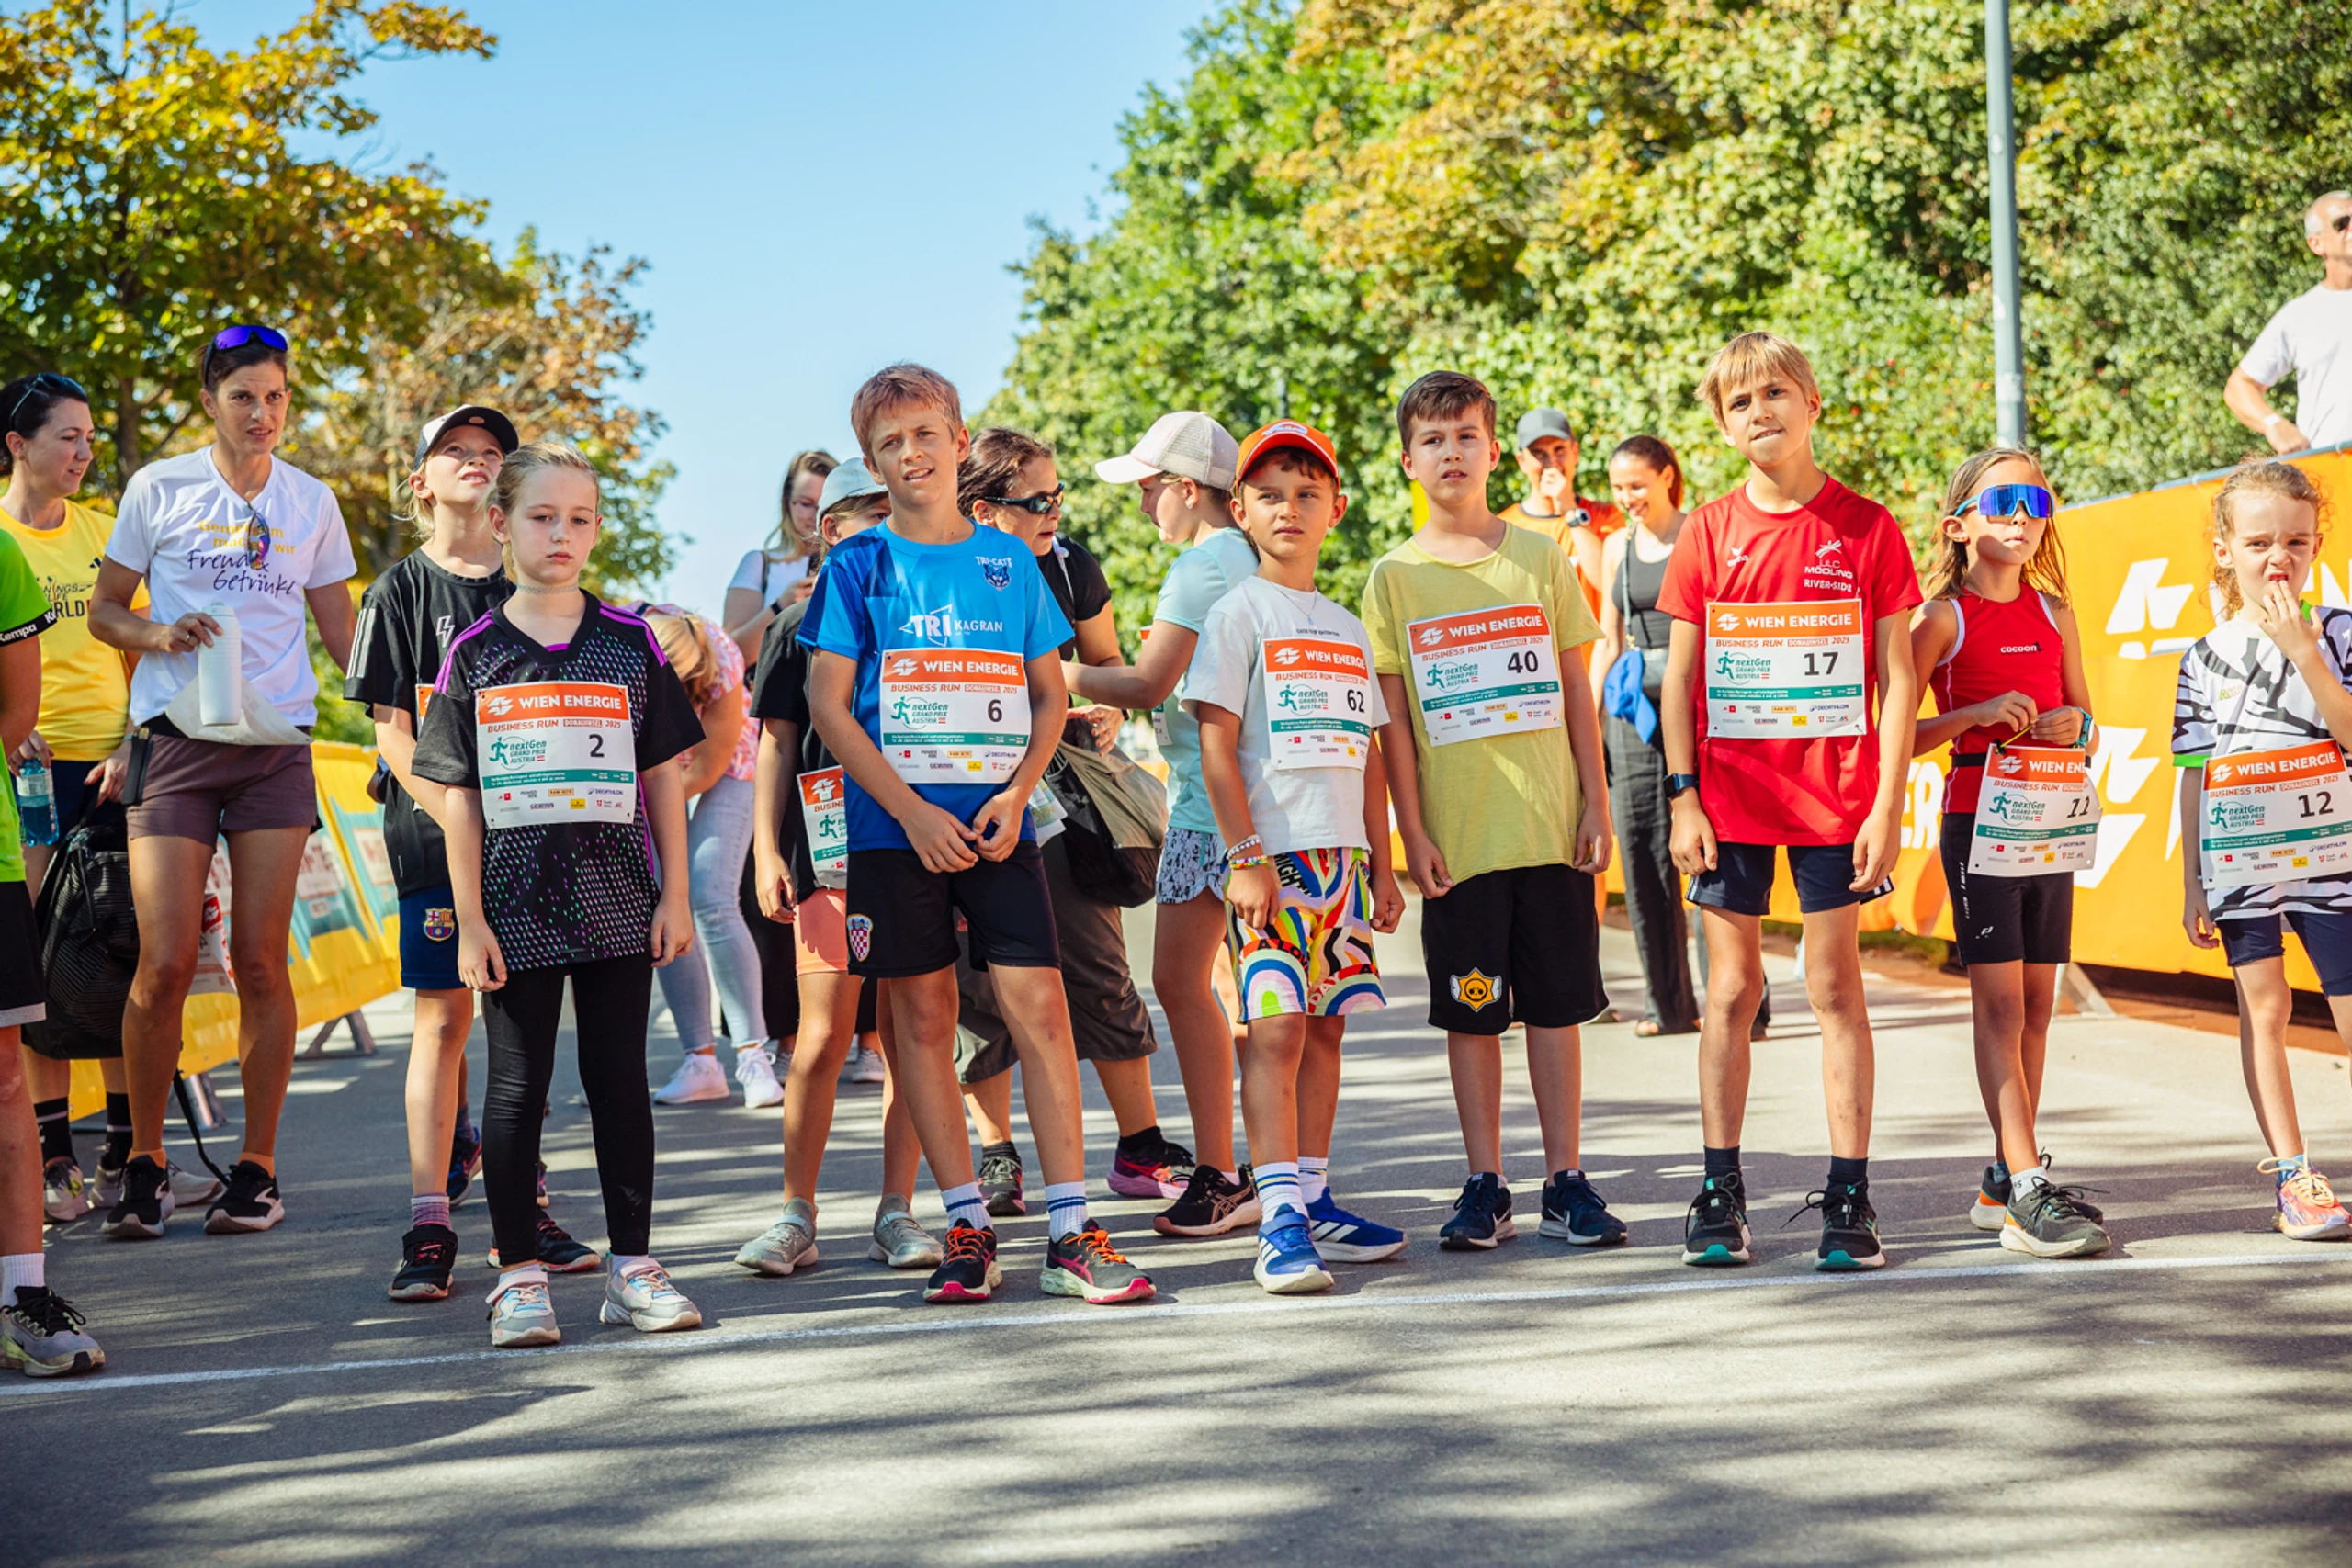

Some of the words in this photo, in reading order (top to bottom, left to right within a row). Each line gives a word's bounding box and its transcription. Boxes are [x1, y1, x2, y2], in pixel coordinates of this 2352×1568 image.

[274, 542, 296, 555] wir
[187, 549, 251, 570] Freud
[53, 599, 85, 618] RLD
[910, 615, 952, 637] TRI
[955, 620, 1003, 632] KAGRAN
[1448, 623, 1487, 637] WIEN
[1489, 615, 1543, 632] ENERGIE
[1745, 616, 1785, 628] WIEN
[1789, 614, 1852, 627] ENERGIE
[1305, 650, 1332, 663] WIEN
[1422, 648, 1465, 661] BUSINESS
[1467, 644, 1487, 653] RUN
[2000, 645, 2038, 653] cocoon
[922, 661, 963, 673] WIEN
[967, 661, 1019, 676] ENERGIE
[1507, 650, 1539, 674] 40
[1804, 651, 1839, 676] 17
[1275, 672, 1317, 681] BUSINESS
[890, 684, 937, 693] BUSINESS
[518, 695, 560, 709] WIEN
[564, 694, 622, 710] ENERGIE
[1346, 689, 1365, 714] 62
[988, 699, 1002, 723] 6
[487, 722, 534, 733] BUSINESS
[537, 719, 559, 728] RUN
[588, 734, 605, 758] 2
[2029, 761, 2064, 773] WIEN
[2236, 762, 2276, 776] WIEN
[2279, 752, 2337, 772] ENERGIE
[1994, 780, 2039, 791] BUSINESS
[2210, 787, 2251, 798] BUSINESS
[2255, 785, 2276, 794] RUN
[2298, 791, 2334, 818] 12
